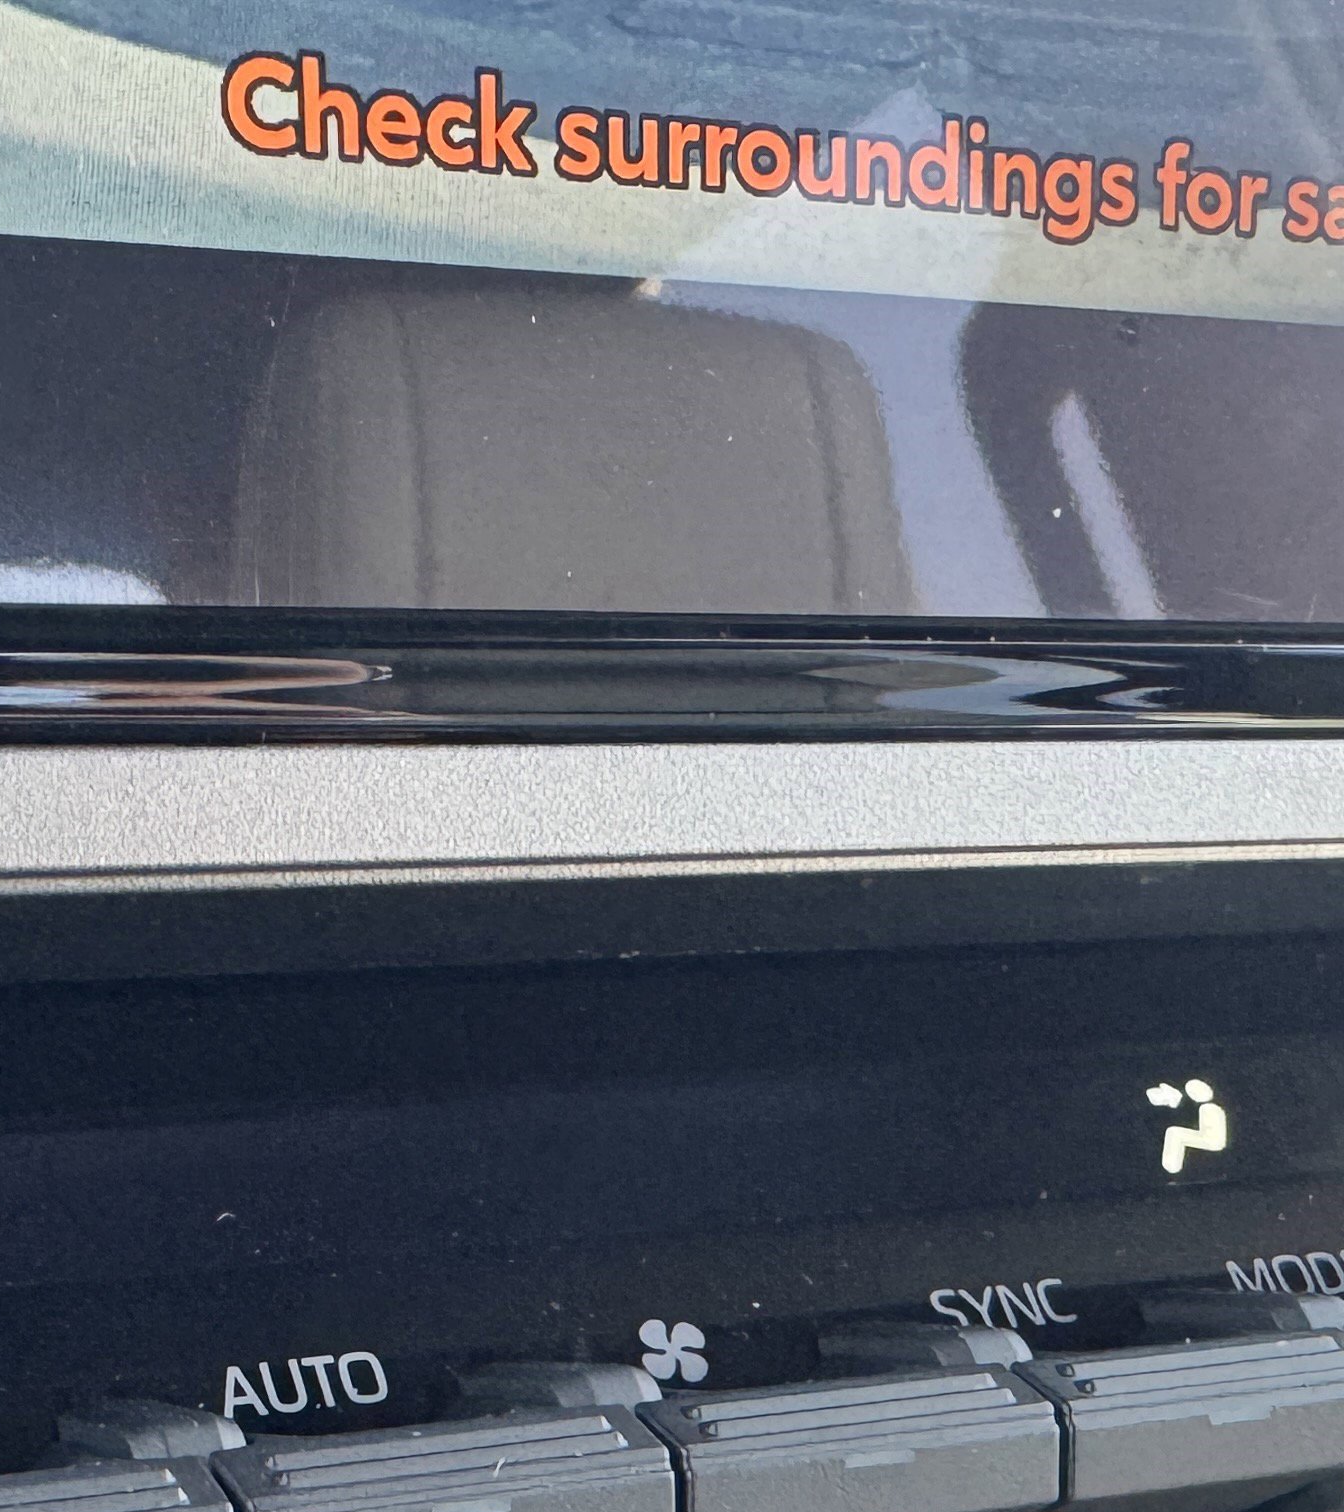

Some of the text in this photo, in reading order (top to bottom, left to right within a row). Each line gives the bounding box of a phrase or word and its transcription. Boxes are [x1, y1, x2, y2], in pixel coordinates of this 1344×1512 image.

[224, 53, 536, 175] Check
[557, 110, 1135, 241] surroundings
[1157, 139, 1269, 233] for
[928, 1277, 1079, 1328] SYNC
[222, 1350, 390, 1420] AUTO
